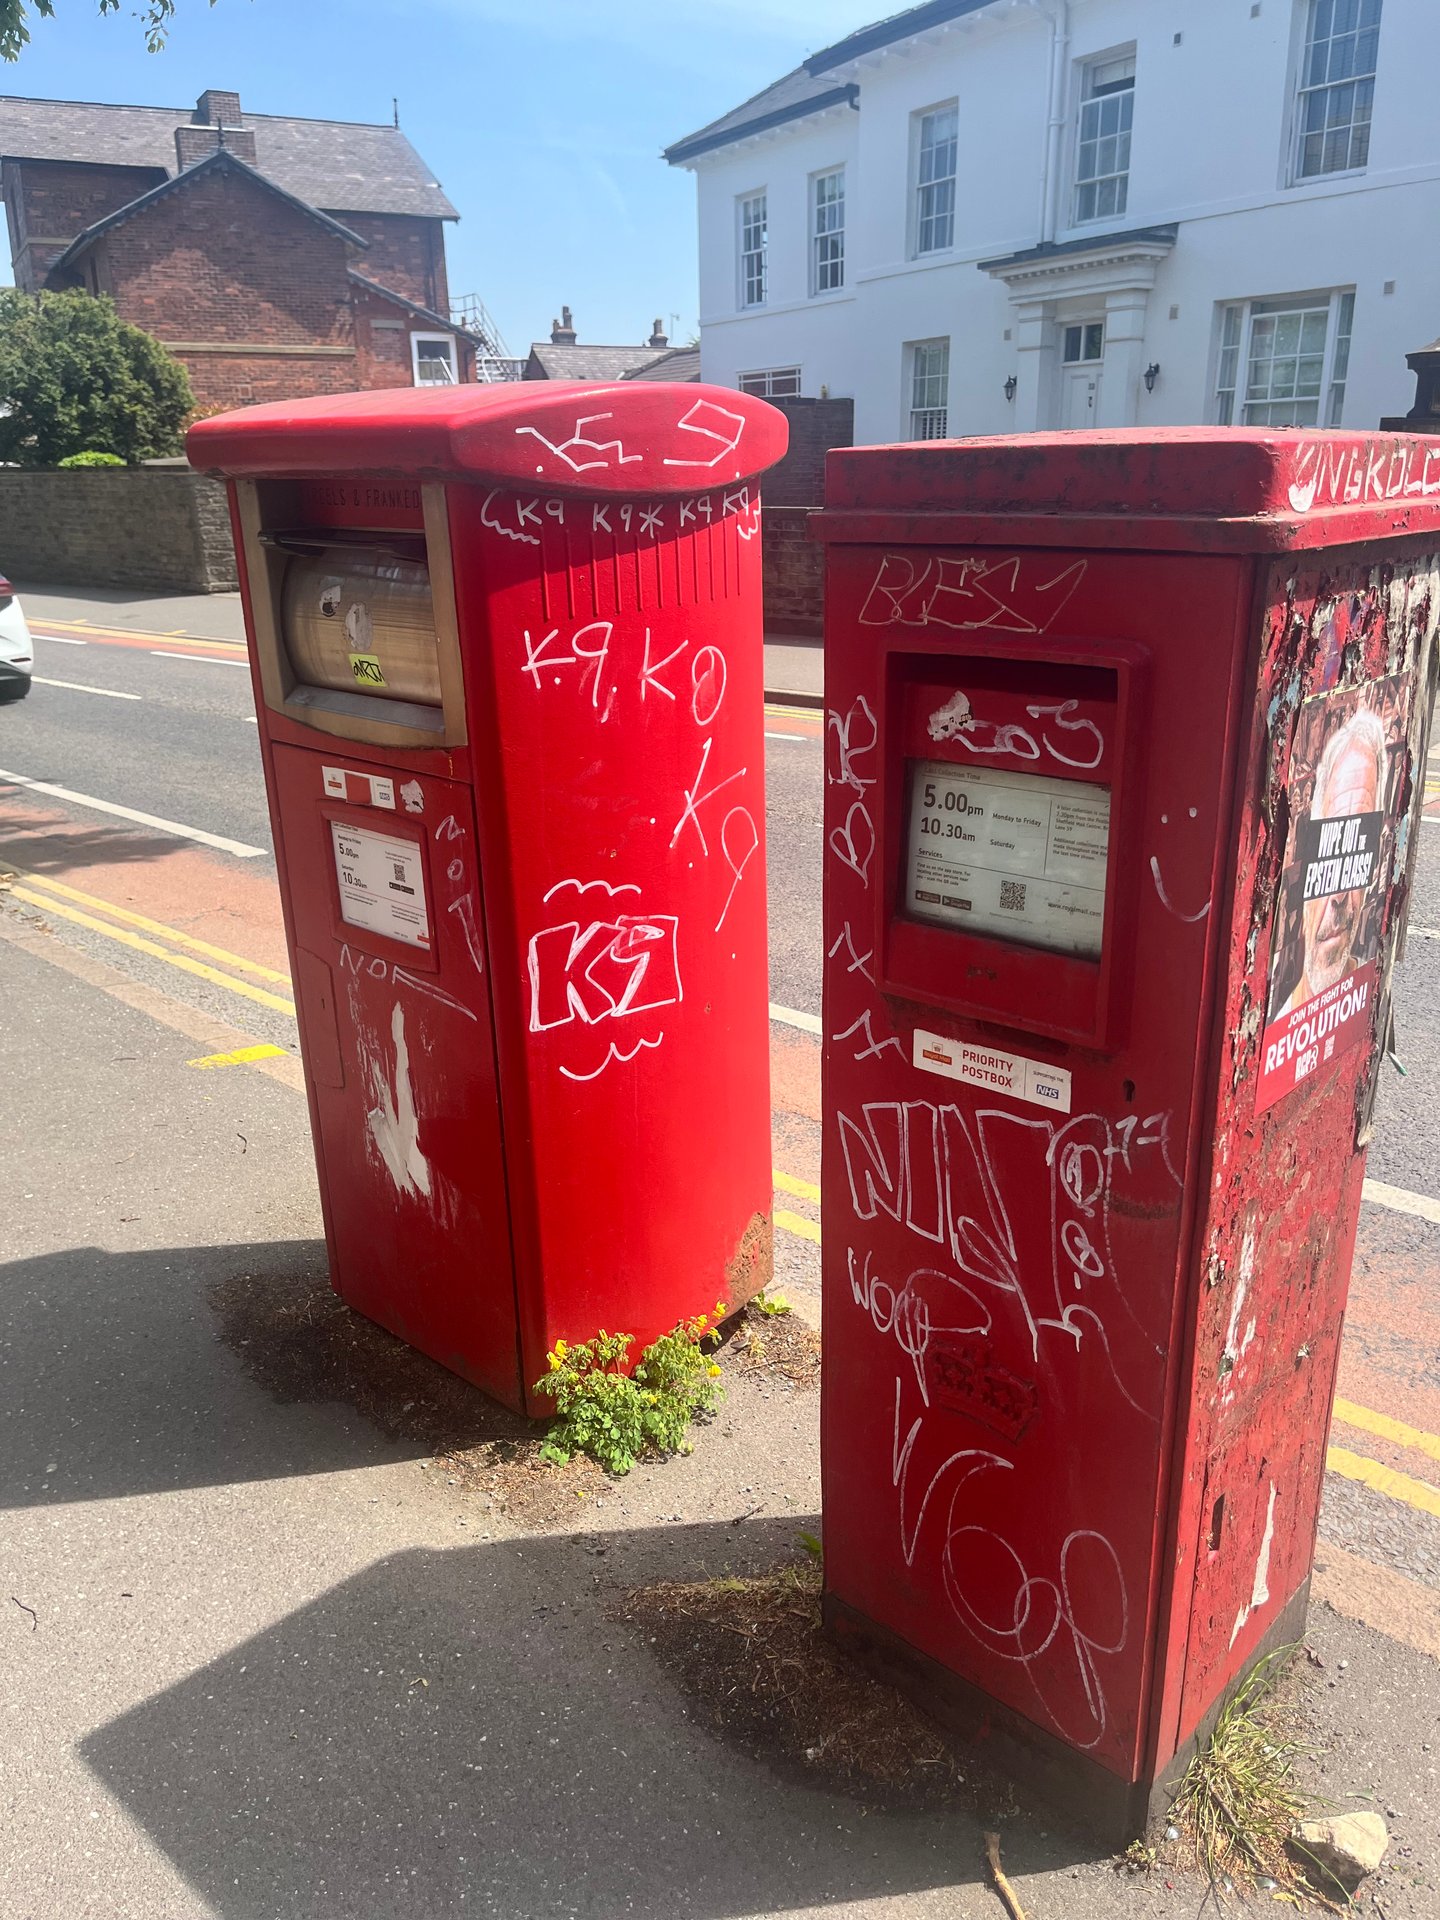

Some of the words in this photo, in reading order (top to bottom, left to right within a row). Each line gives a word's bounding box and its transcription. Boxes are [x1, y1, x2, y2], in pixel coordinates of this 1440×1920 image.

[516, 499, 566, 527] K9
[680, 495, 712, 527] K9
[923, 783, 984, 816] 5.00pm
[920, 816, 976, 843] 10.30am
[992, 813, 1015, 824] Monday
[1023, 817, 1042, 827] Friday
[338, 842, 360, 860] 5.00pm
[990, 839, 1015, 850] Saturday
[1317, 820, 1345, 859] WIPE
[1341, 818, 1362, 854] OUT
[918, 847, 943, 859] Services
[342, 871, 368, 889] 10.30am
[1303, 857, 1343, 899] EPSTEIN
[1340, 851, 1374, 891] CLASS!
[1288, 1006, 1306, 1029] JOIN
[1307, 1001, 1320, 1016] THE
[1320, 984, 1340, 1008] FIGHT
[1341, 976, 1354, 995] FOR
[1263, 981, 1369, 1076] REVOLUTION!
[962, 1049, 1014, 1073] PRIORITY
[962, 1064, 1013, 1089] POSTBOX
[1037, 1085, 1059, 1098] NHS
